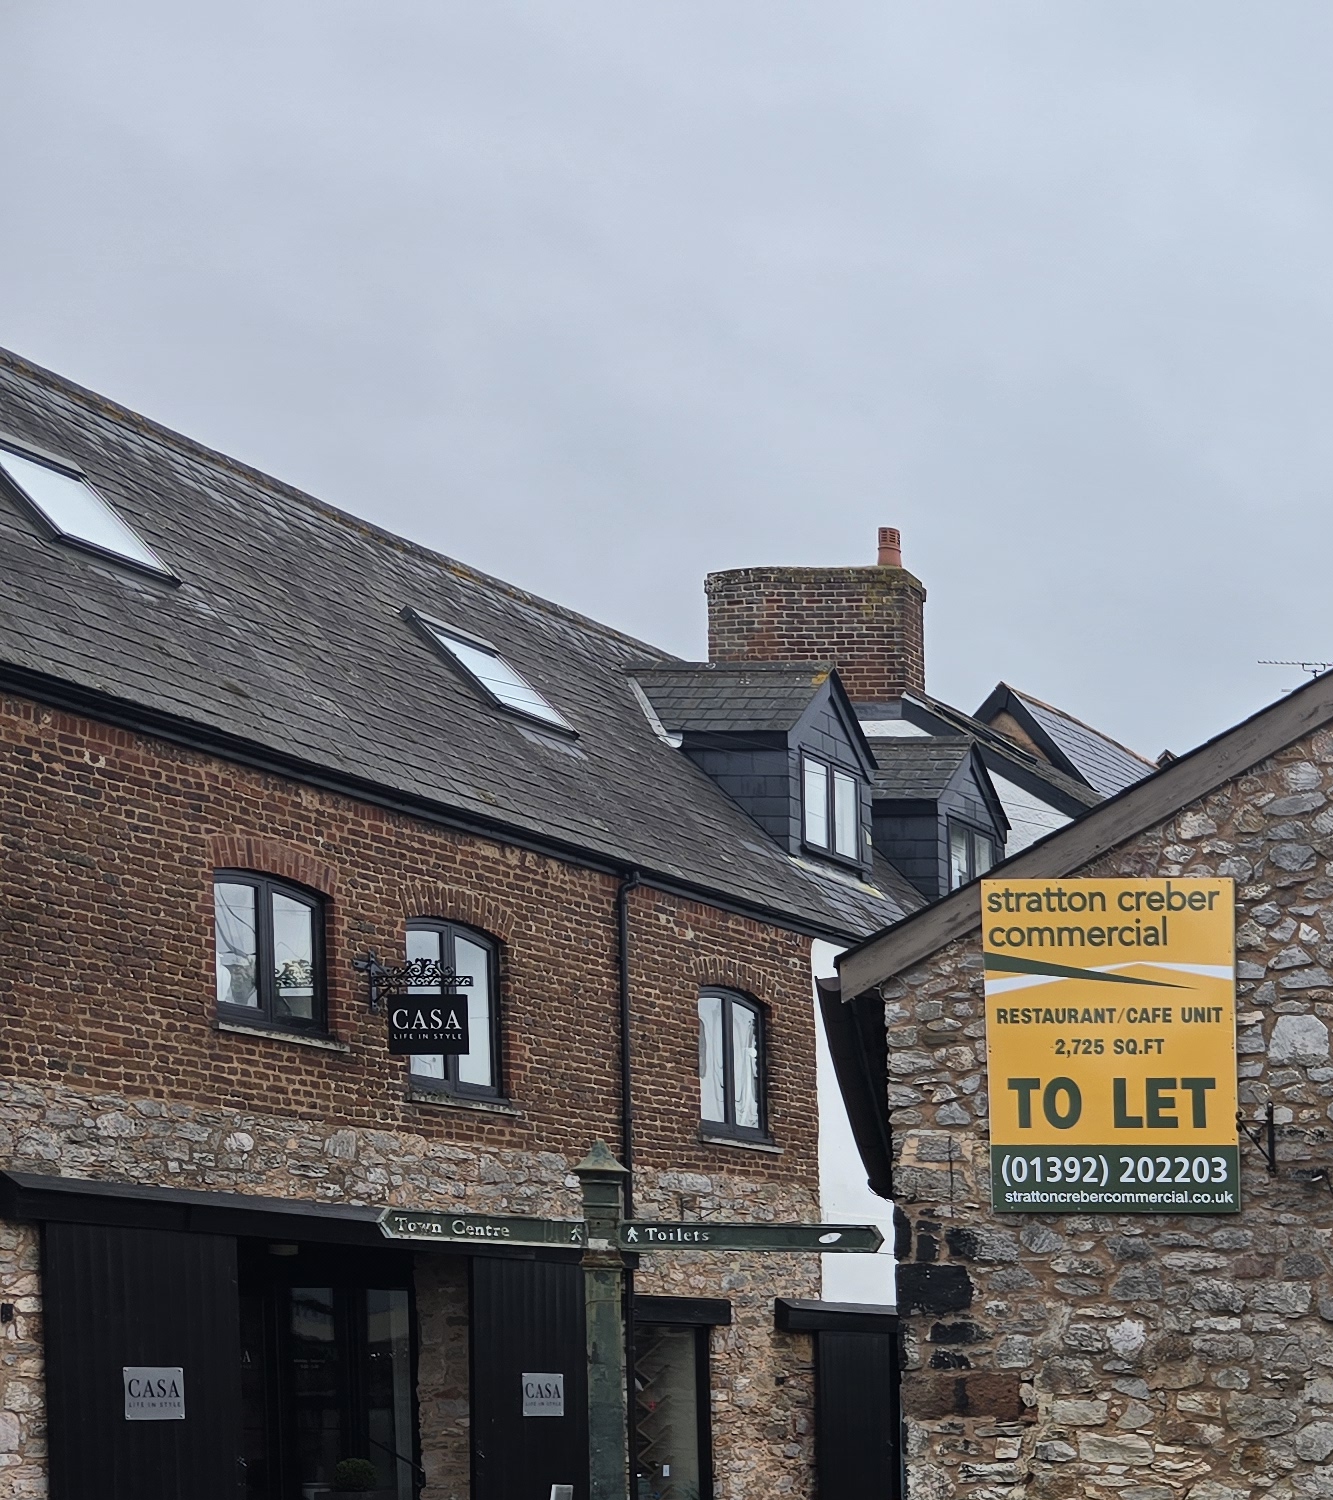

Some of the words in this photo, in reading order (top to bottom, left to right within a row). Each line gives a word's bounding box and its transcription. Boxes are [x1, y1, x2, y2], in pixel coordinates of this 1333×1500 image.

[987, 888, 1106, 913] stratton
[1118, 882, 1219, 912] creber
[989, 917, 1168, 947] commercial
[393, 1009, 462, 1029] CASA
[997, 1008, 1172, 1023] RESTAURANT/CAFE
[1182, 1007, 1223, 1023] UNIT
[1055, 1039, 1105, 1057] 2,725
[1113, 1039, 1164, 1055] SQ.FT
[1008, 1077, 1082, 1129] TO
[1113, 1078, 1216, 1128] LET
[1002, 1155, 1108, 1186] (01392)
[1119, 1157, 1227, 1183] 202203
[1005, 1190, 1233, 1204] strattoncrebercommercial.co.uk
[395, 1217, 441, 1233] Town
[452, 1220, 509, 1236] Centre
[645, 1228, 710, 1242] Toilets
[128, 1379, 180, 1398] CASA
[526, 1383, 560, 1398] CASA
